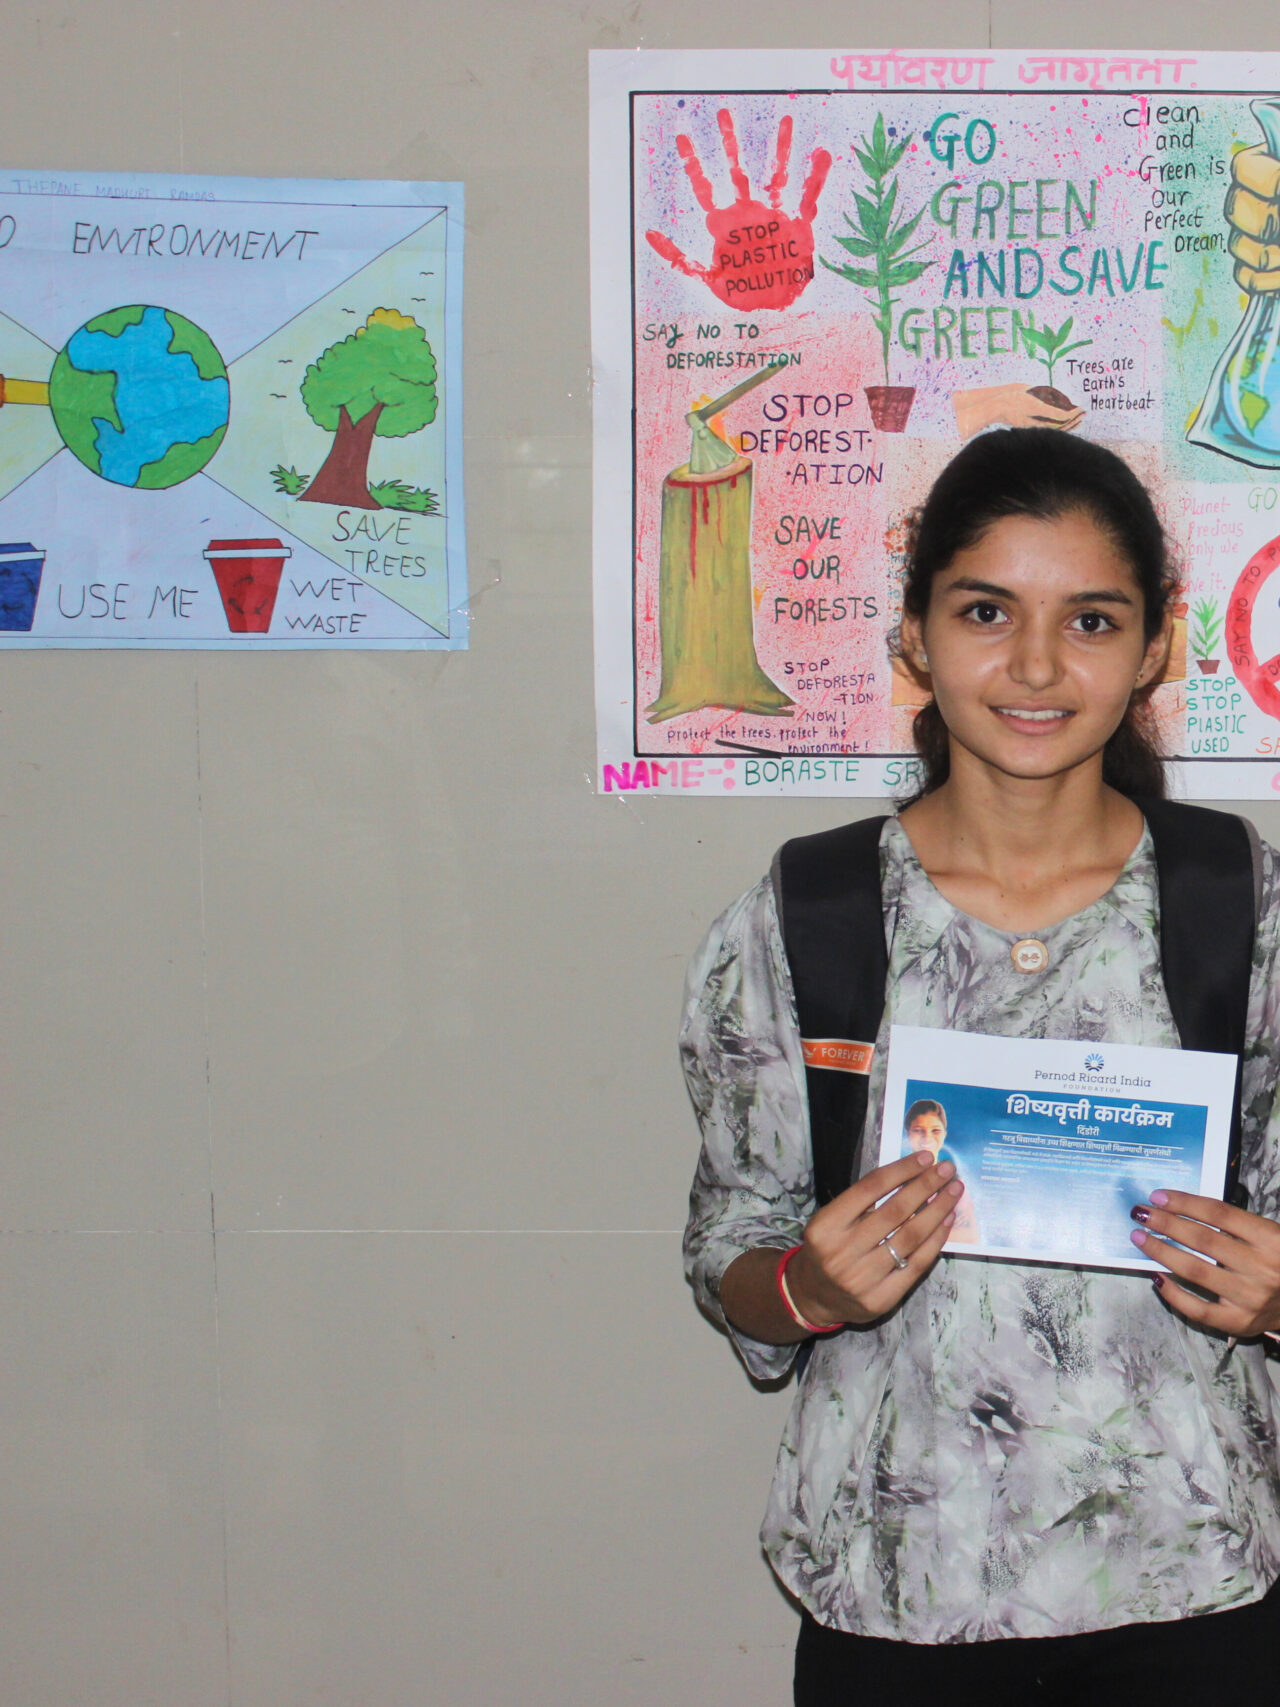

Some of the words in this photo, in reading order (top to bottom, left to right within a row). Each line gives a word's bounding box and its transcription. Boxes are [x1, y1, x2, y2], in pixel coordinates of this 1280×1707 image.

[930, 112, 996, 171] GO
[1156, 122, 1194, 150] and
[1139, 155, 1196, 184] Green
[1210, 156, 1226, 176] is
[930, 179, 1098, 239] GREEN
[73, 221, 319, 261] ENVIRONMENT
[727, 221, 780, 245] STOP
[720, 241, 799, 271] PLASTIC
[726, 267, 814, 296] POLLUTION
[697, 324, 720, 339] NO
[734, 324, 759, 339] TO
[900, 307, 1037, 360] GREEN
[667, 351, 801, 369] DEFORESTATION
[1066, 359, 1104, 375] Trees
[1112, 357, 1134, 371] are
[1083, 375, 1125, 391] Earth's
[763, 393, 854, 423] STOP
[1248, 487, 1278, 512] GO
[332, 511, 411, 545] SAVE
[775, 515, 842, 545] SAVE
[346, 549, 427, 578] TREES
[793, 555, 841, 585] OUR
[1243, 566, 1261, 584] TO
[57, 583, 130, 620] USE
[149, 585, 199, 619] ME
[290, 579, 364, 602] WET
[1235, 597, 1248, 622] NO
[285, 614, 367, 634] WASTE
[1233, 632, 1250, 667] SAY
[784, 658, 830, 675] STOP
[797, 673, 875, 691] DEFORESTA
[1185, 677, 1235, 692] STOP
[1186, 693, 1241, 710] STOP
[667, 728, 711, 743] protect
[720, 724, 736, 739] the
[779, 726, 819, 741] protect
[829, 725, 846, 738] the
[1187, 714, 1246, 733] PLASTIC
[1192, 737, 1229, 754] USED
[745, 760, 860, 785] BORASTE
[1034, 1070, 1075, 1081] Pernod
[1079, 1072, 1117, 1085] Ricard
[1120, 1075, 1152, 1087] India
[1063, 1084, 1121, 1093] FOUNDATION
[1006, 1094, 1091, 1125] शिष्यवृत्ती
[1094, 1103, 1174, 1128] कार्यक्रम
[1076, 1125, 1100, 1136] दिंडोरी
